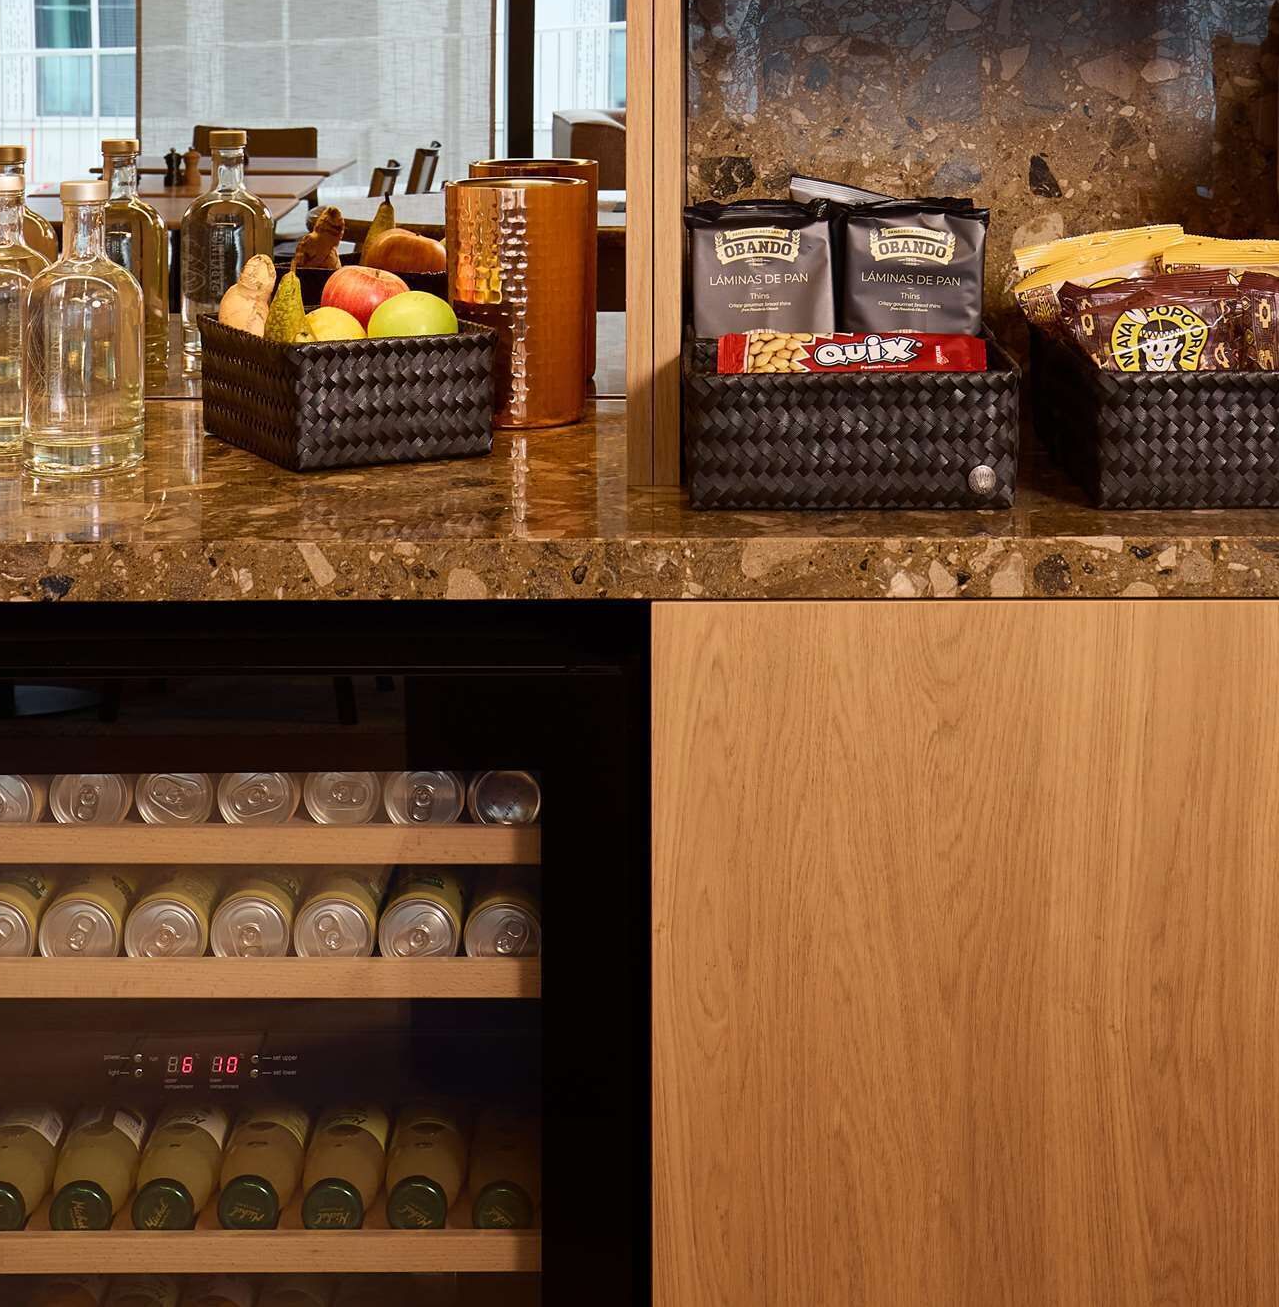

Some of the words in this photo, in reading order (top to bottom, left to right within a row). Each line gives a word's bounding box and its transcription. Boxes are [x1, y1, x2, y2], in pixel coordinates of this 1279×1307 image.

[724, 240, 793, 259] OBANDO
[878, 240, 947, 259] OBANDO
[709, 273, 762, 286] LÁMINAS
[765, 274, 781, 284] DE
[784, 273, 808, 284] PAN
[861, 270, 914, 284] LÁMINAS
[917, 275, 933, 285] DE
[936, 276, 961, 286] PAN
[750, 292, 770, 300] Thins
[878, 300, 893, 308] Crispy
[900, 292, 920, 300] Thins
[1121, 321, 1138, 367] MAYA
[1143, 305, 1206, 365] POPCORN
[181, 1056, 193, 1073] 6
